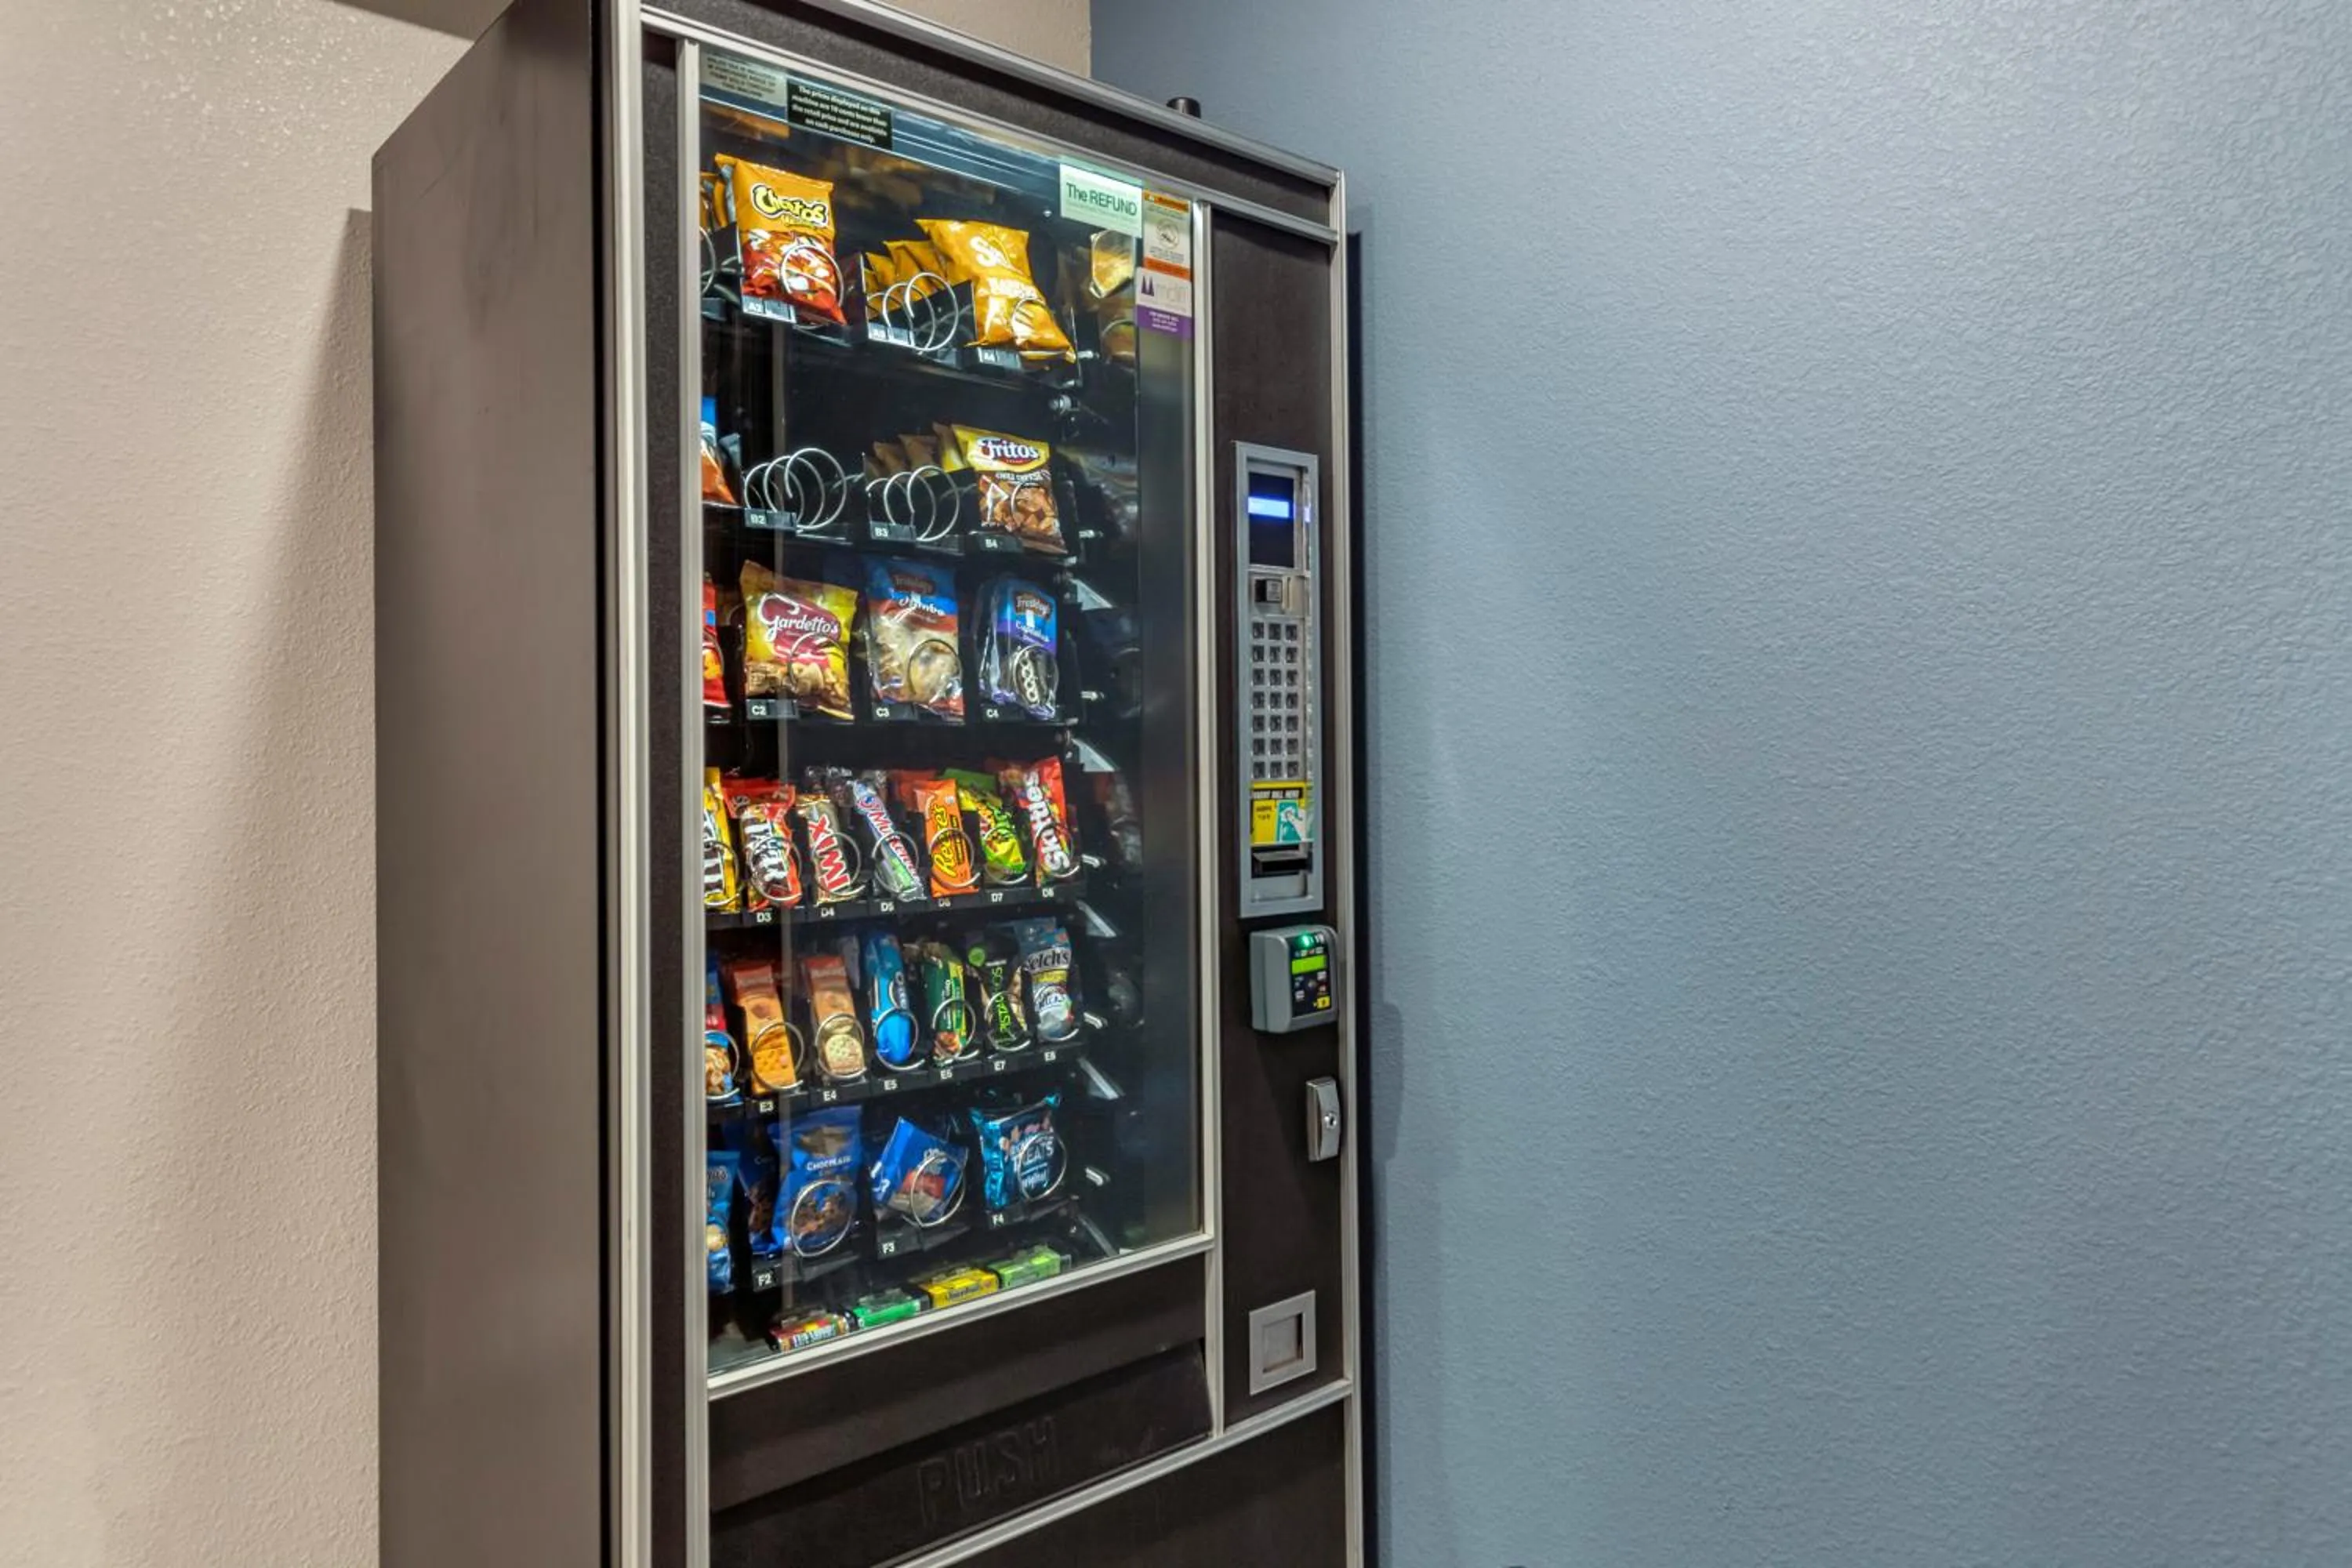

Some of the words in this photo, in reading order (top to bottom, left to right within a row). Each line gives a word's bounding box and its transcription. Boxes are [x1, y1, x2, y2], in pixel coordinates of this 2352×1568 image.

[1065, 182, 1087, 202] The
[1089, 190, 1138, 216] REFUND
[977, 436, 1039, 461] Fritos
[750, 514, 766, 524] B2
[874, 526, 889, 537] B3
[757, 593, 839, 642] Gardetto's
[751, 704, 767, 716] C2
[876, 706, 891, 718] C3
[985, 708, 1000, 719] C4
[808, 813, 851, 894] TWIX
[990, 892, 1004, 903] D7
[820, 907, 836, 918] D4
[880, 901, 895, 913] D5
[756, 911, 772, 924] D3
[993, 1059, 1007, 1072] E7
[883, 1078, 899, 1091] E5
[822, 1089, 837, 1102] E4
[759, 1099, 775, 1113] E3
[992, 1212, 1005, 1228] F4
[882, 1241, 895, 1254] F3
[757, 1272, 772, 1287] F2
[916, 1414, 1059, 1528] PUSH
